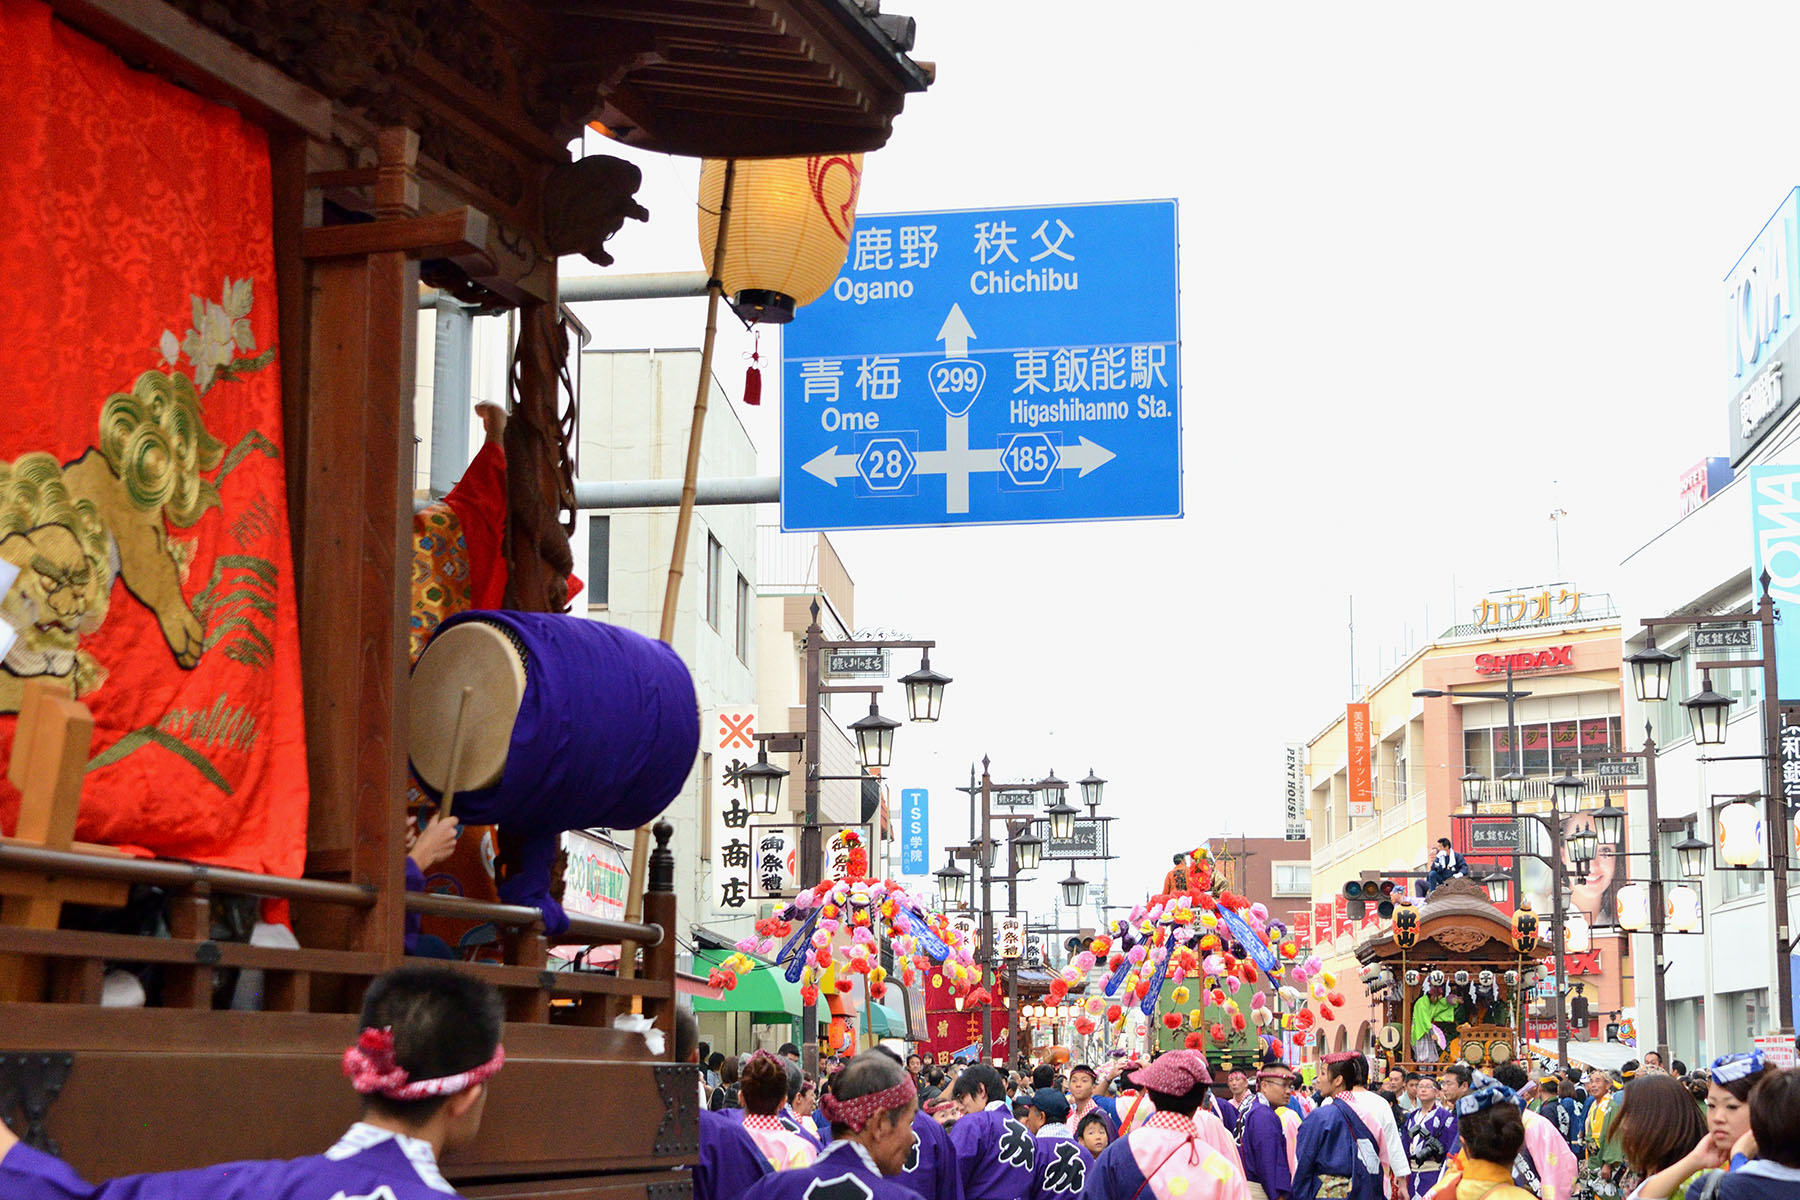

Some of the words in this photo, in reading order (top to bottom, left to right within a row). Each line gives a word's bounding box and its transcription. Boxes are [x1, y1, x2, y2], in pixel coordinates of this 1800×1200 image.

[844, 224, 939, 272] 鹿野
[973, 218, 1076, 265] 秩父
[833, 276, 914, 305] Ogano
[970, 267, 1079, 296] Chichibu
[799, 356, 902, 404] 青梅
[1012, 344, 1169, 396] 東飯能駅
[936, 366, 978, 393] 299
[820, 407, 880, 432] Ome
[1009, 398, 1129, 428] Higashihanno
[1137, 394, 1172, 419] Sta.
[868, 450, 903, 478] 28
[1009, 444, 1050, 471] 185
[1474, 589, 1582, 627] カラオケ
[1474, 645, 1574, 675] SHIDAX
[1287, 747, 1296, 779] PENT
[1287, 781, 1296, 820] HOUSE
[1354, 804, 1366, 814] 3F
[722, 758, 751, 908] 米由商店
[910, 792, 923, 863] TSS学院
[1396, 909, 1417, 947] 中山
[1517, 914, 1538, 952] 中山
